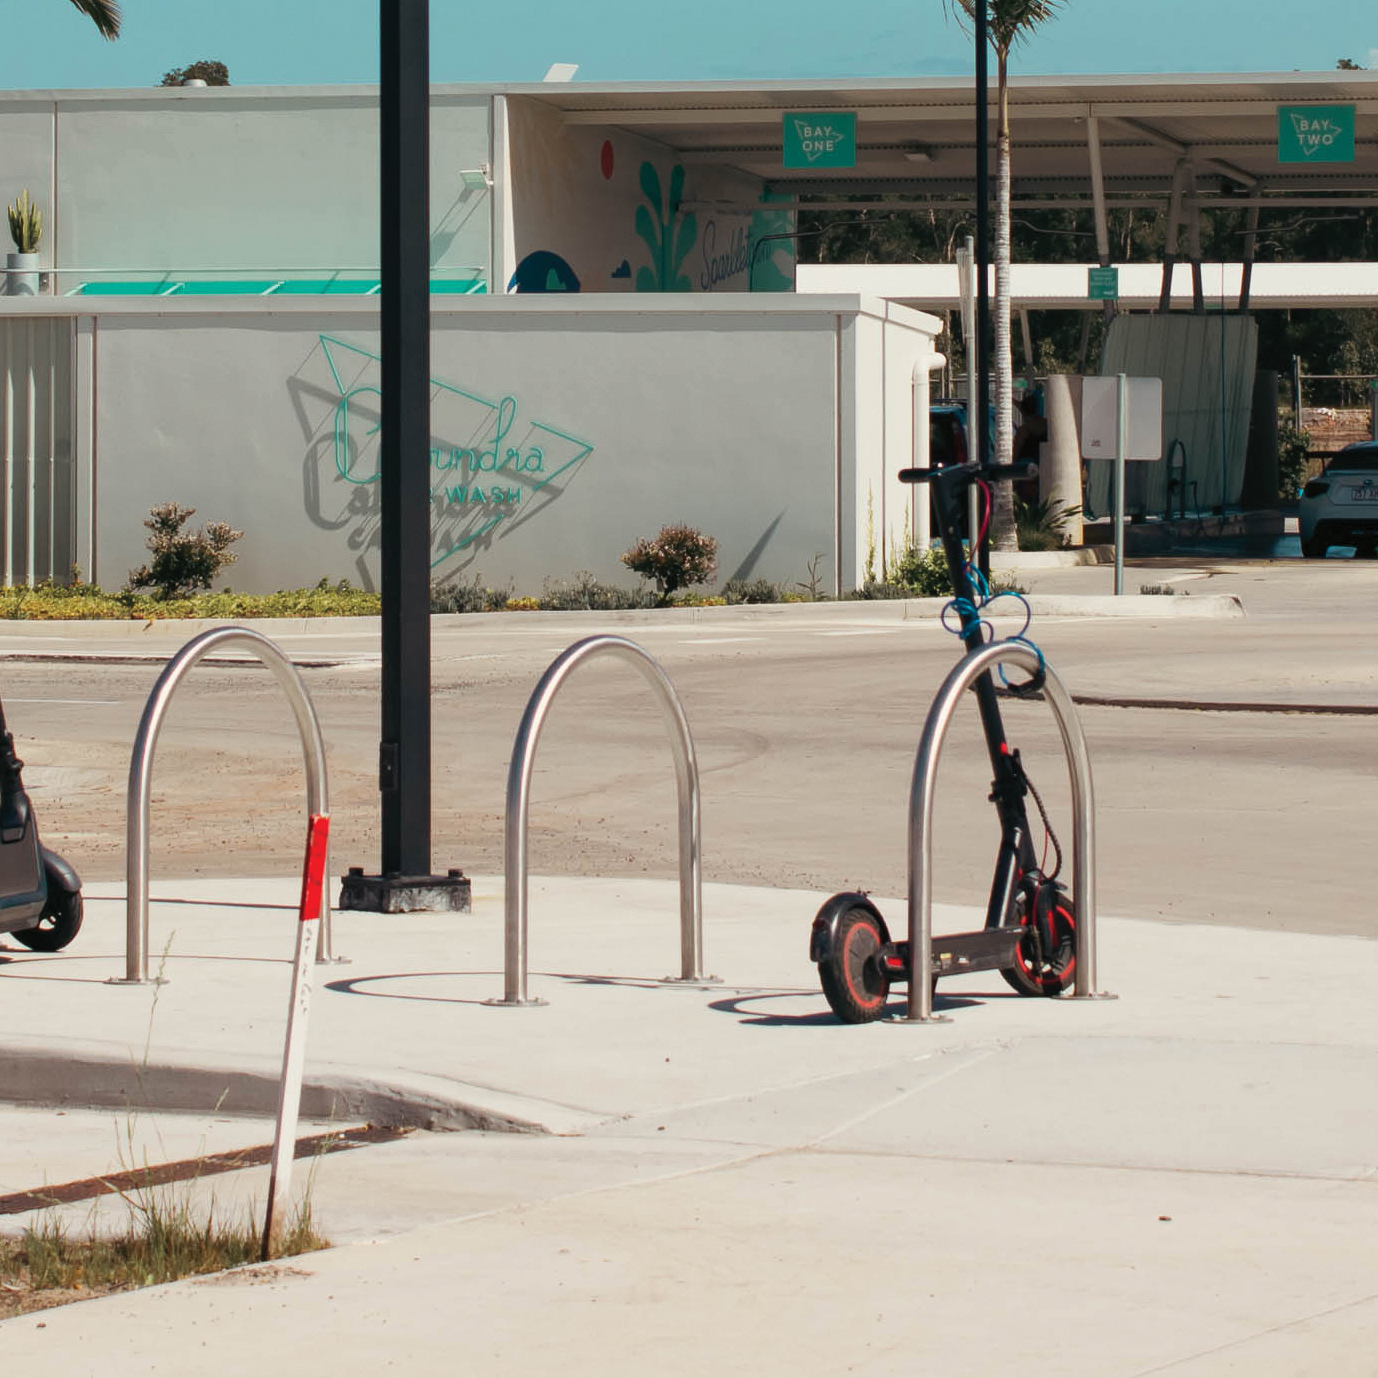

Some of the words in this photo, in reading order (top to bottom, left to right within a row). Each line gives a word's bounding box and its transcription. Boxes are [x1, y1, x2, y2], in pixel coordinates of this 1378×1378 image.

[1300, 118, 1330, 131] BAY
[803, 126, 833, 138] BAY
[802, 140, 835, 151] ONE
[1296, 134, 1335, 146] TWO
[445, 486, 522, 504] WASH
